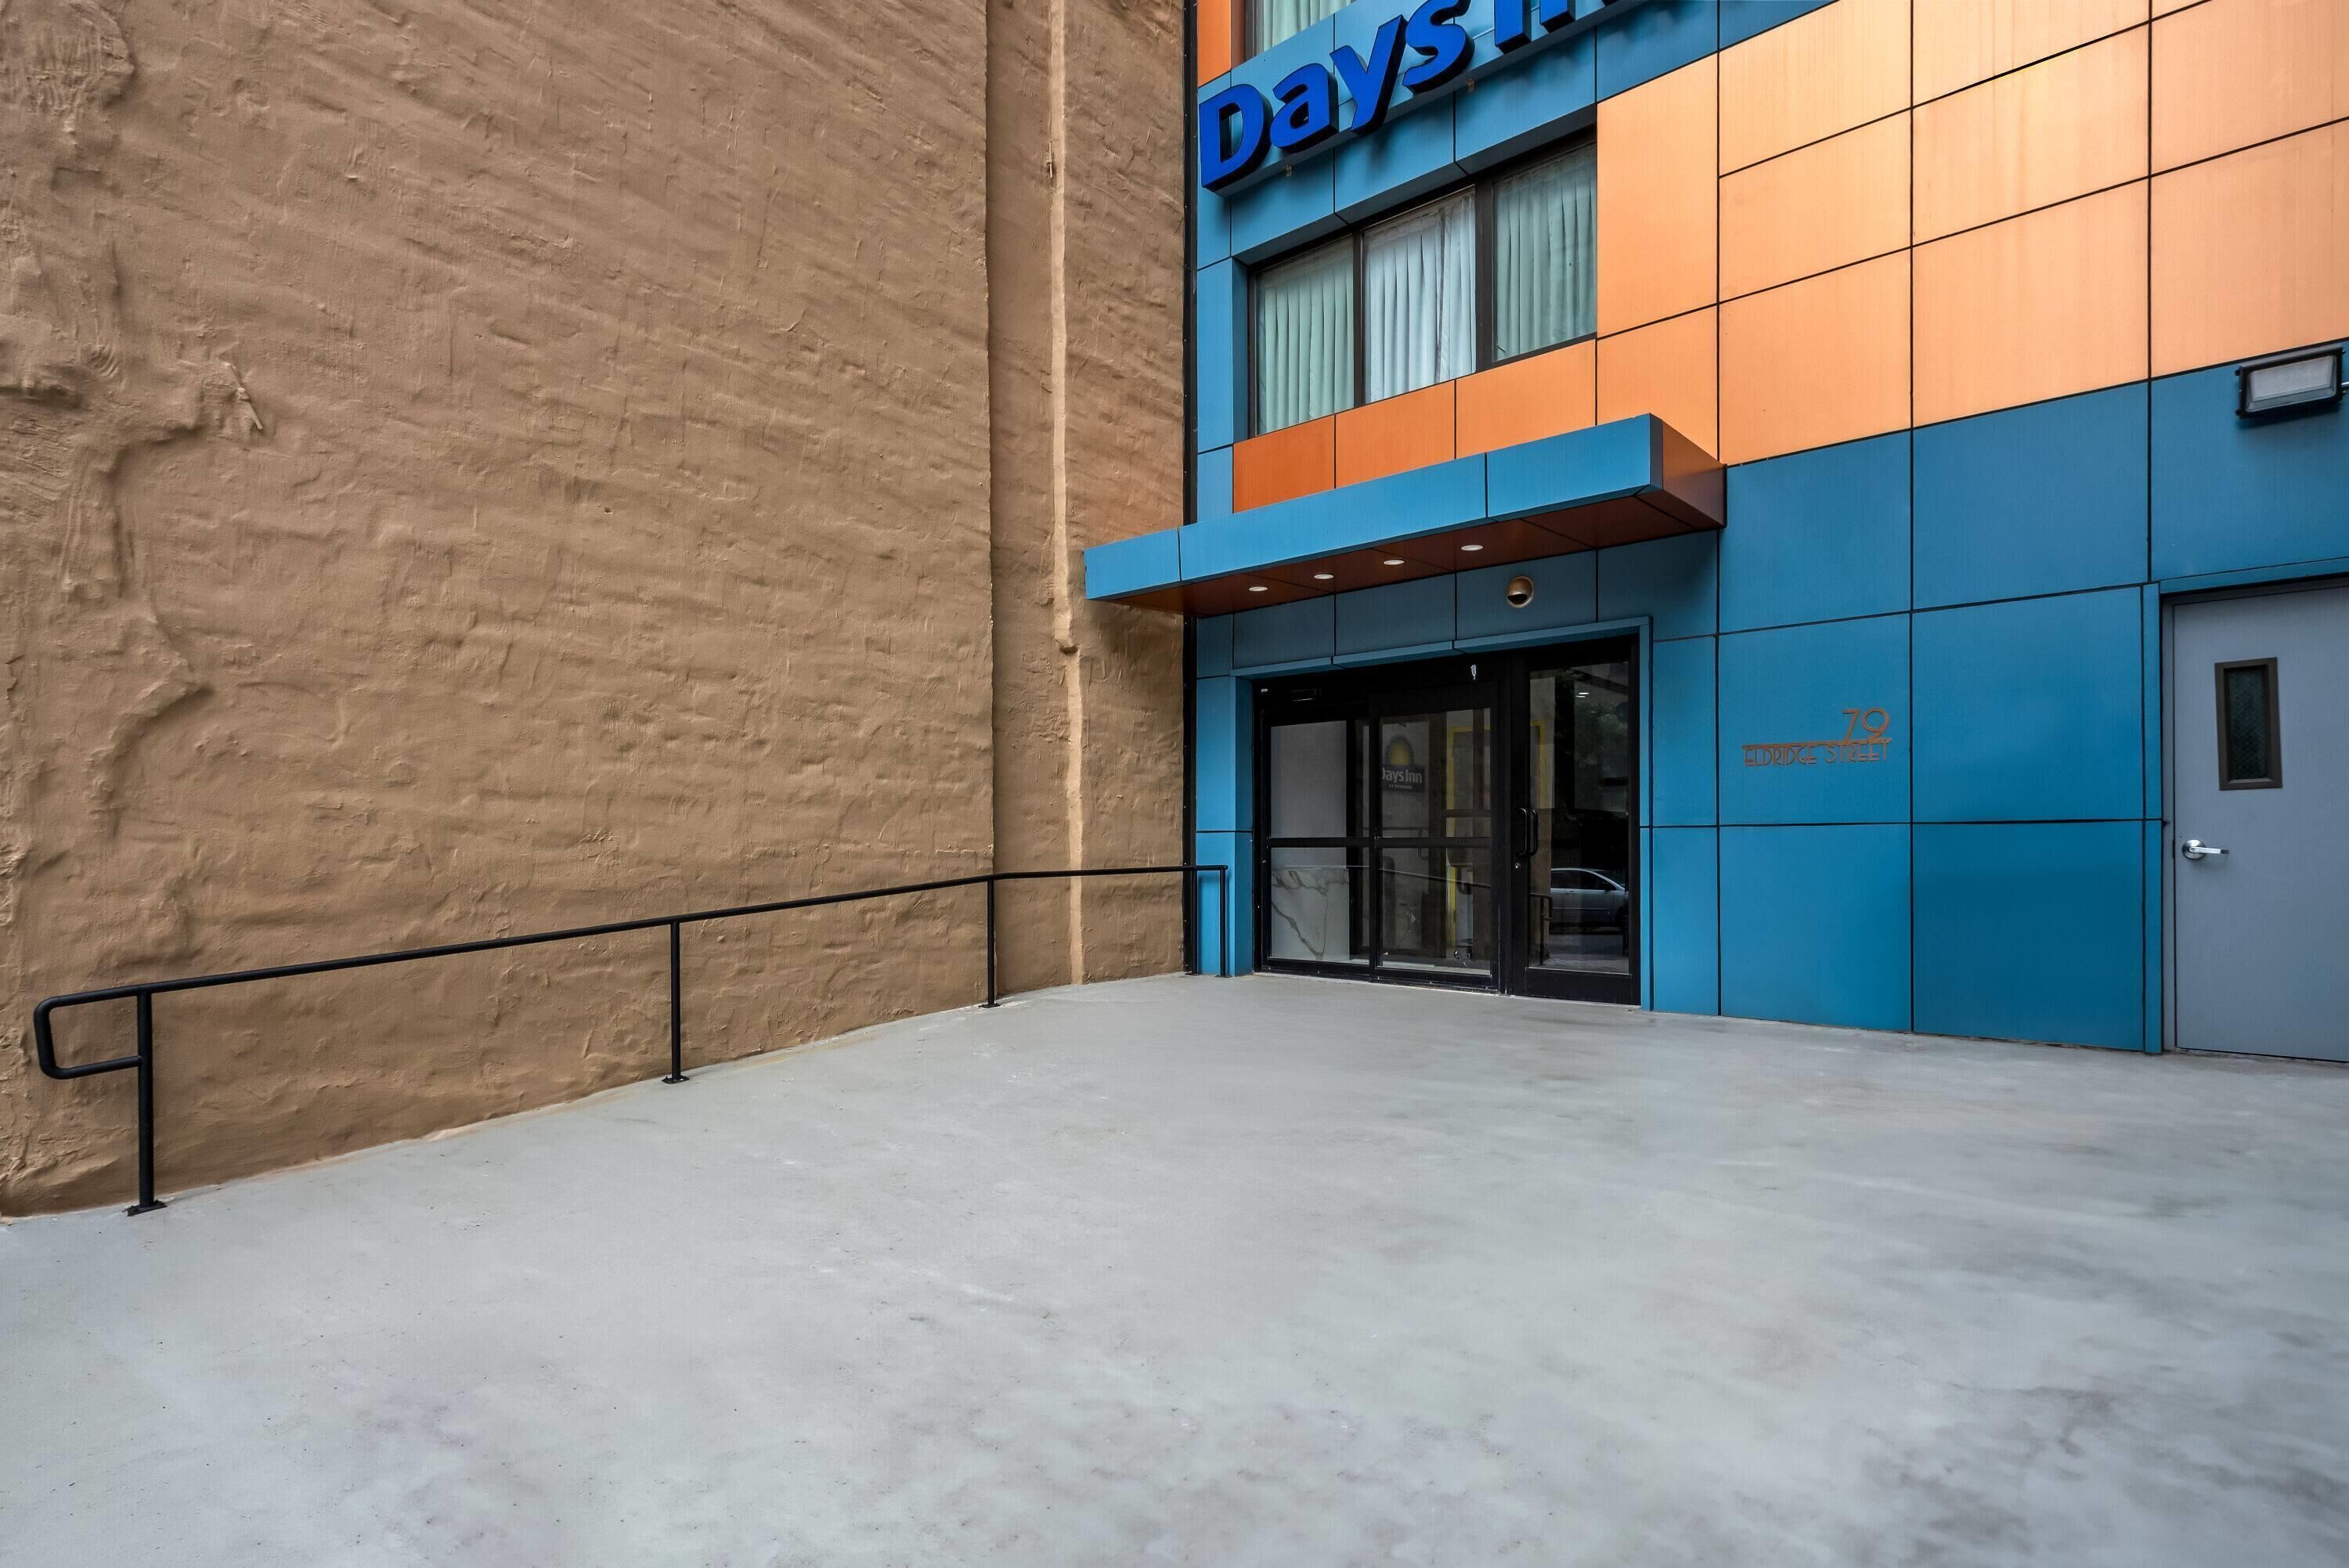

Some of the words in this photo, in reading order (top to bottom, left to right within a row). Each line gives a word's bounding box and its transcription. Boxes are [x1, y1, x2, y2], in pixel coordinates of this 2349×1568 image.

[1199, 0, 1475, 190] Days
[1842, 707, 1890, 741] 79
[1744, 744, 1817, 767] ELDRIDGE
[1825, 742, 1887, 764] STREET
